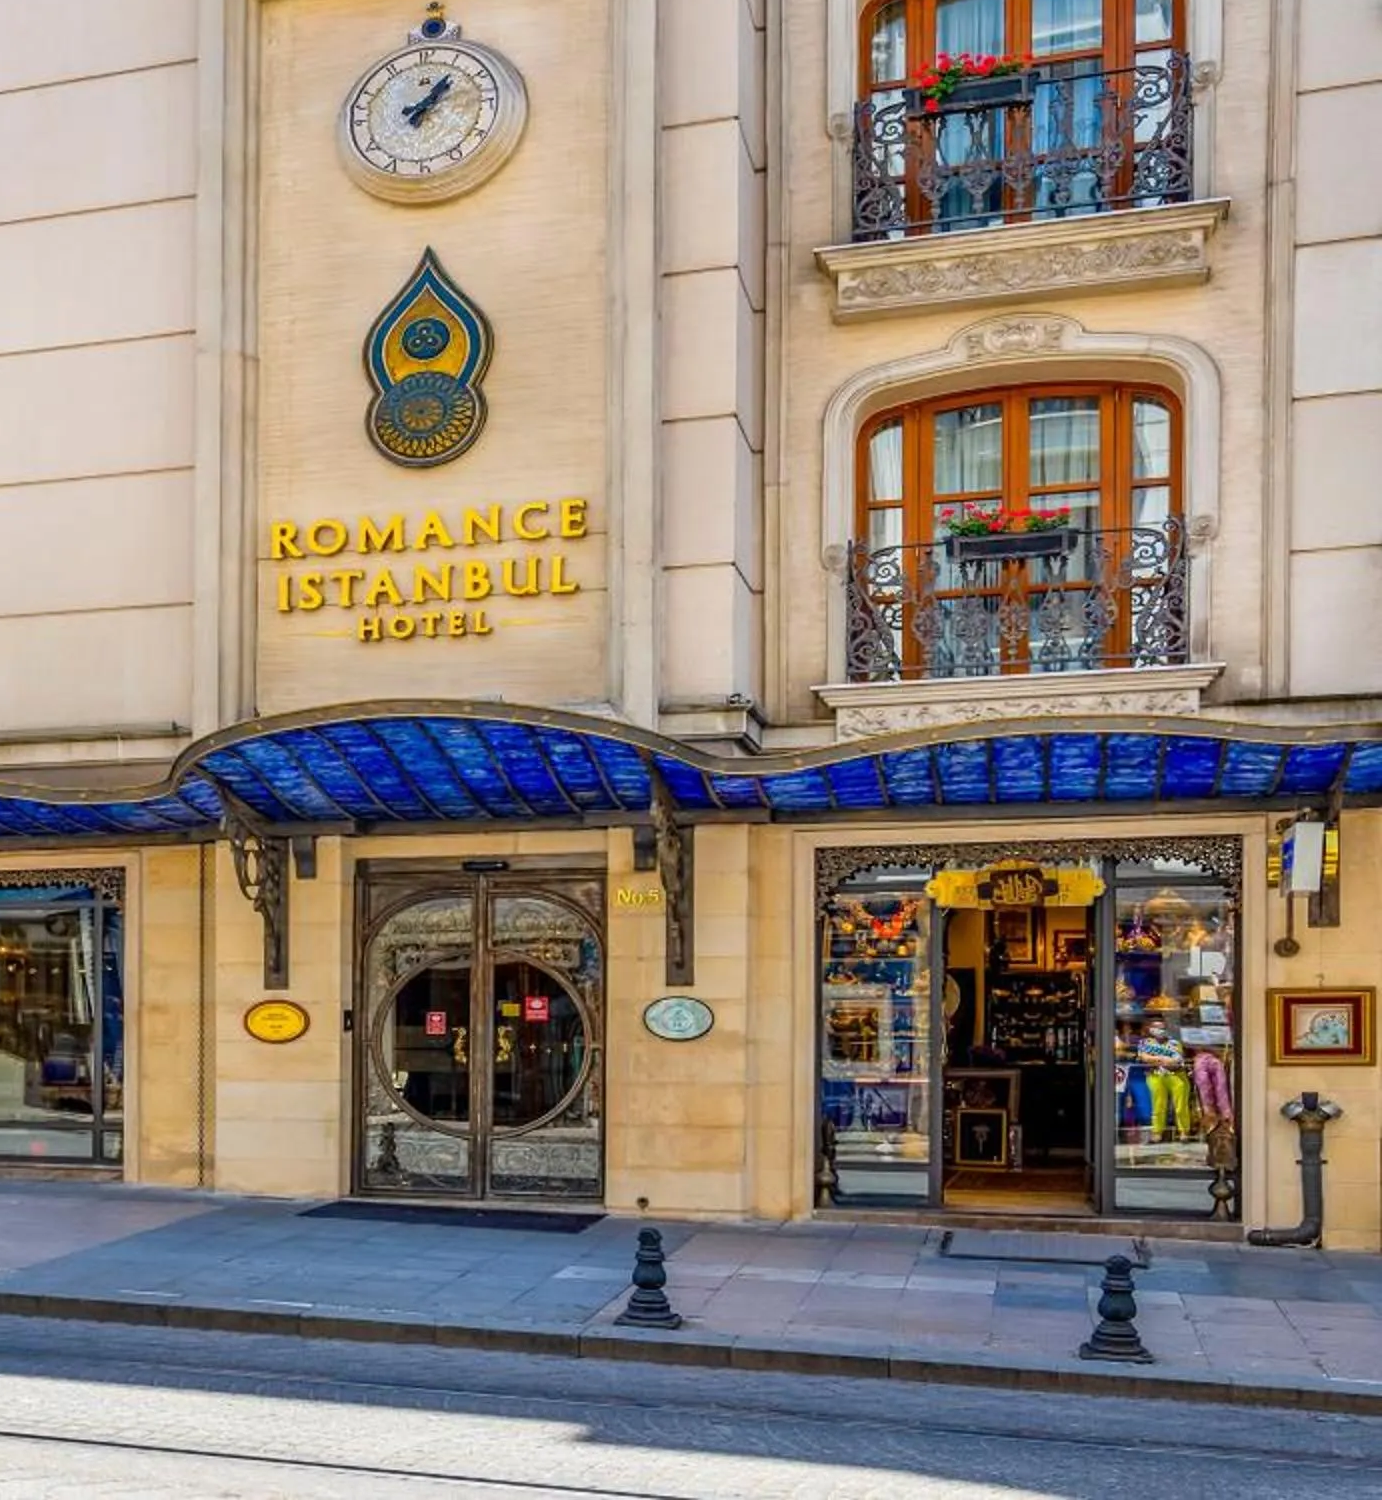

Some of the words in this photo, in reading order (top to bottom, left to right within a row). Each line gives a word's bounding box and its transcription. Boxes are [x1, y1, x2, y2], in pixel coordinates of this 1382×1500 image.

[270, 498, 587, 561] ROMANCE
[277, 555, 579, 613] ISTANBUL
[358, 610, 493, 642] HOTEL
